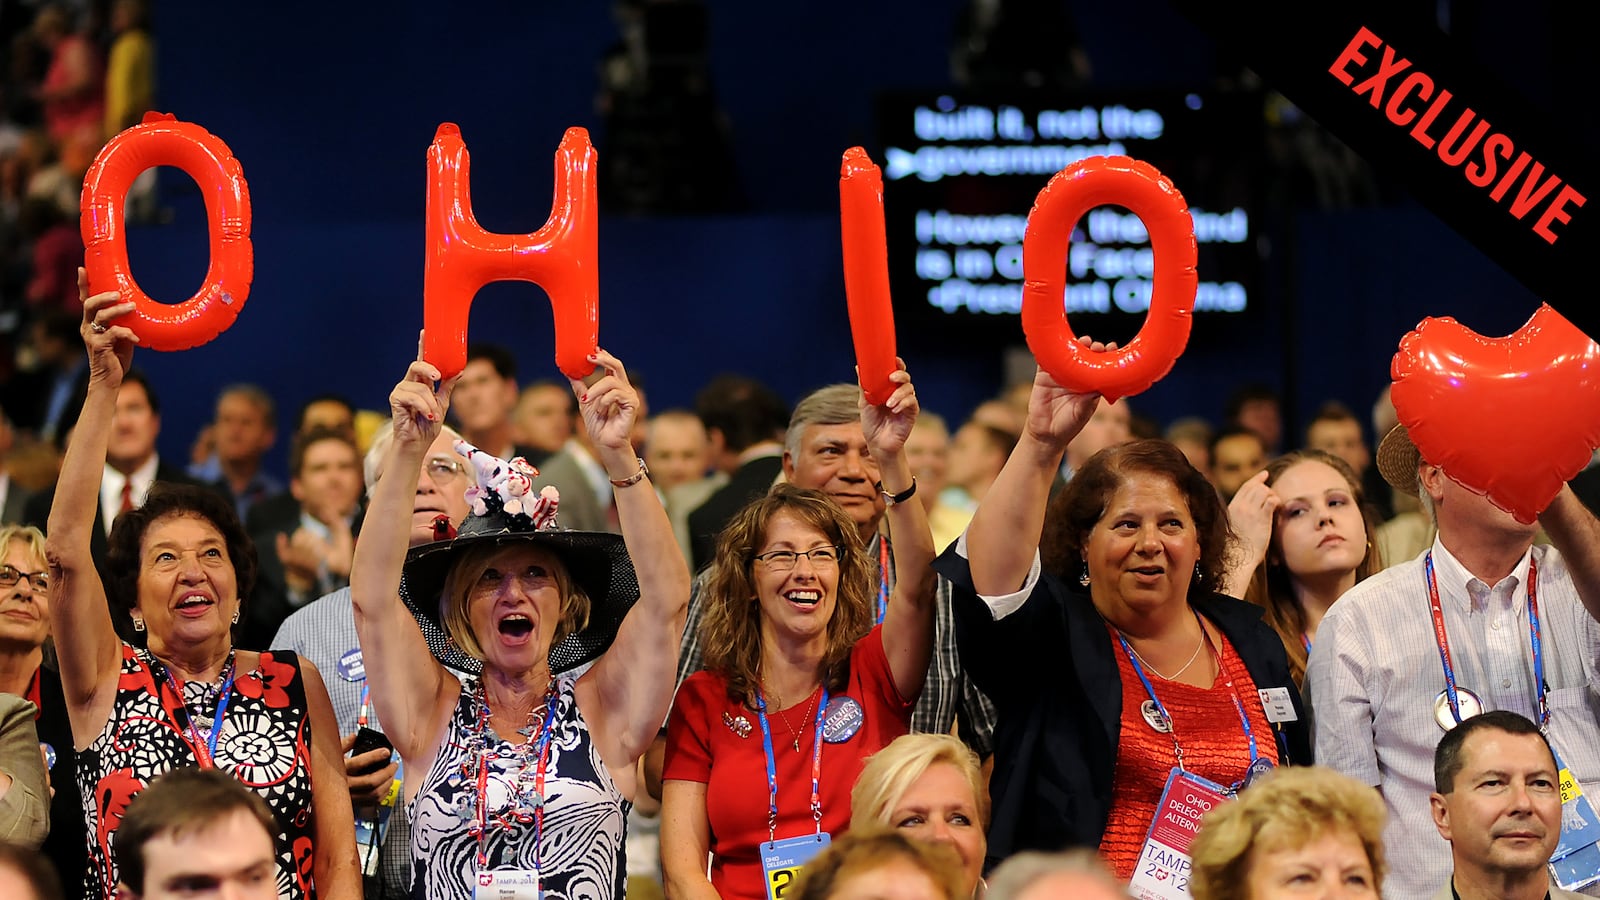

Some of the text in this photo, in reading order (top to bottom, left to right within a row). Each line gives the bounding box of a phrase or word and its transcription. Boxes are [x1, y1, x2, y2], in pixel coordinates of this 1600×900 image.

[915, 106, 995, 140] built
[1037, 106, 1099, 140] not
[1101, 105, 1163, 140] the
[1169, 799, 1203, 820] DELEGA
[1186, 794, 1211, 811] OHIO
[1164, 811, 1200, 834] ALTERN
[767, 859, 794, 868] DELEGATE
[1146, 844, 1192, 876] TAMP
